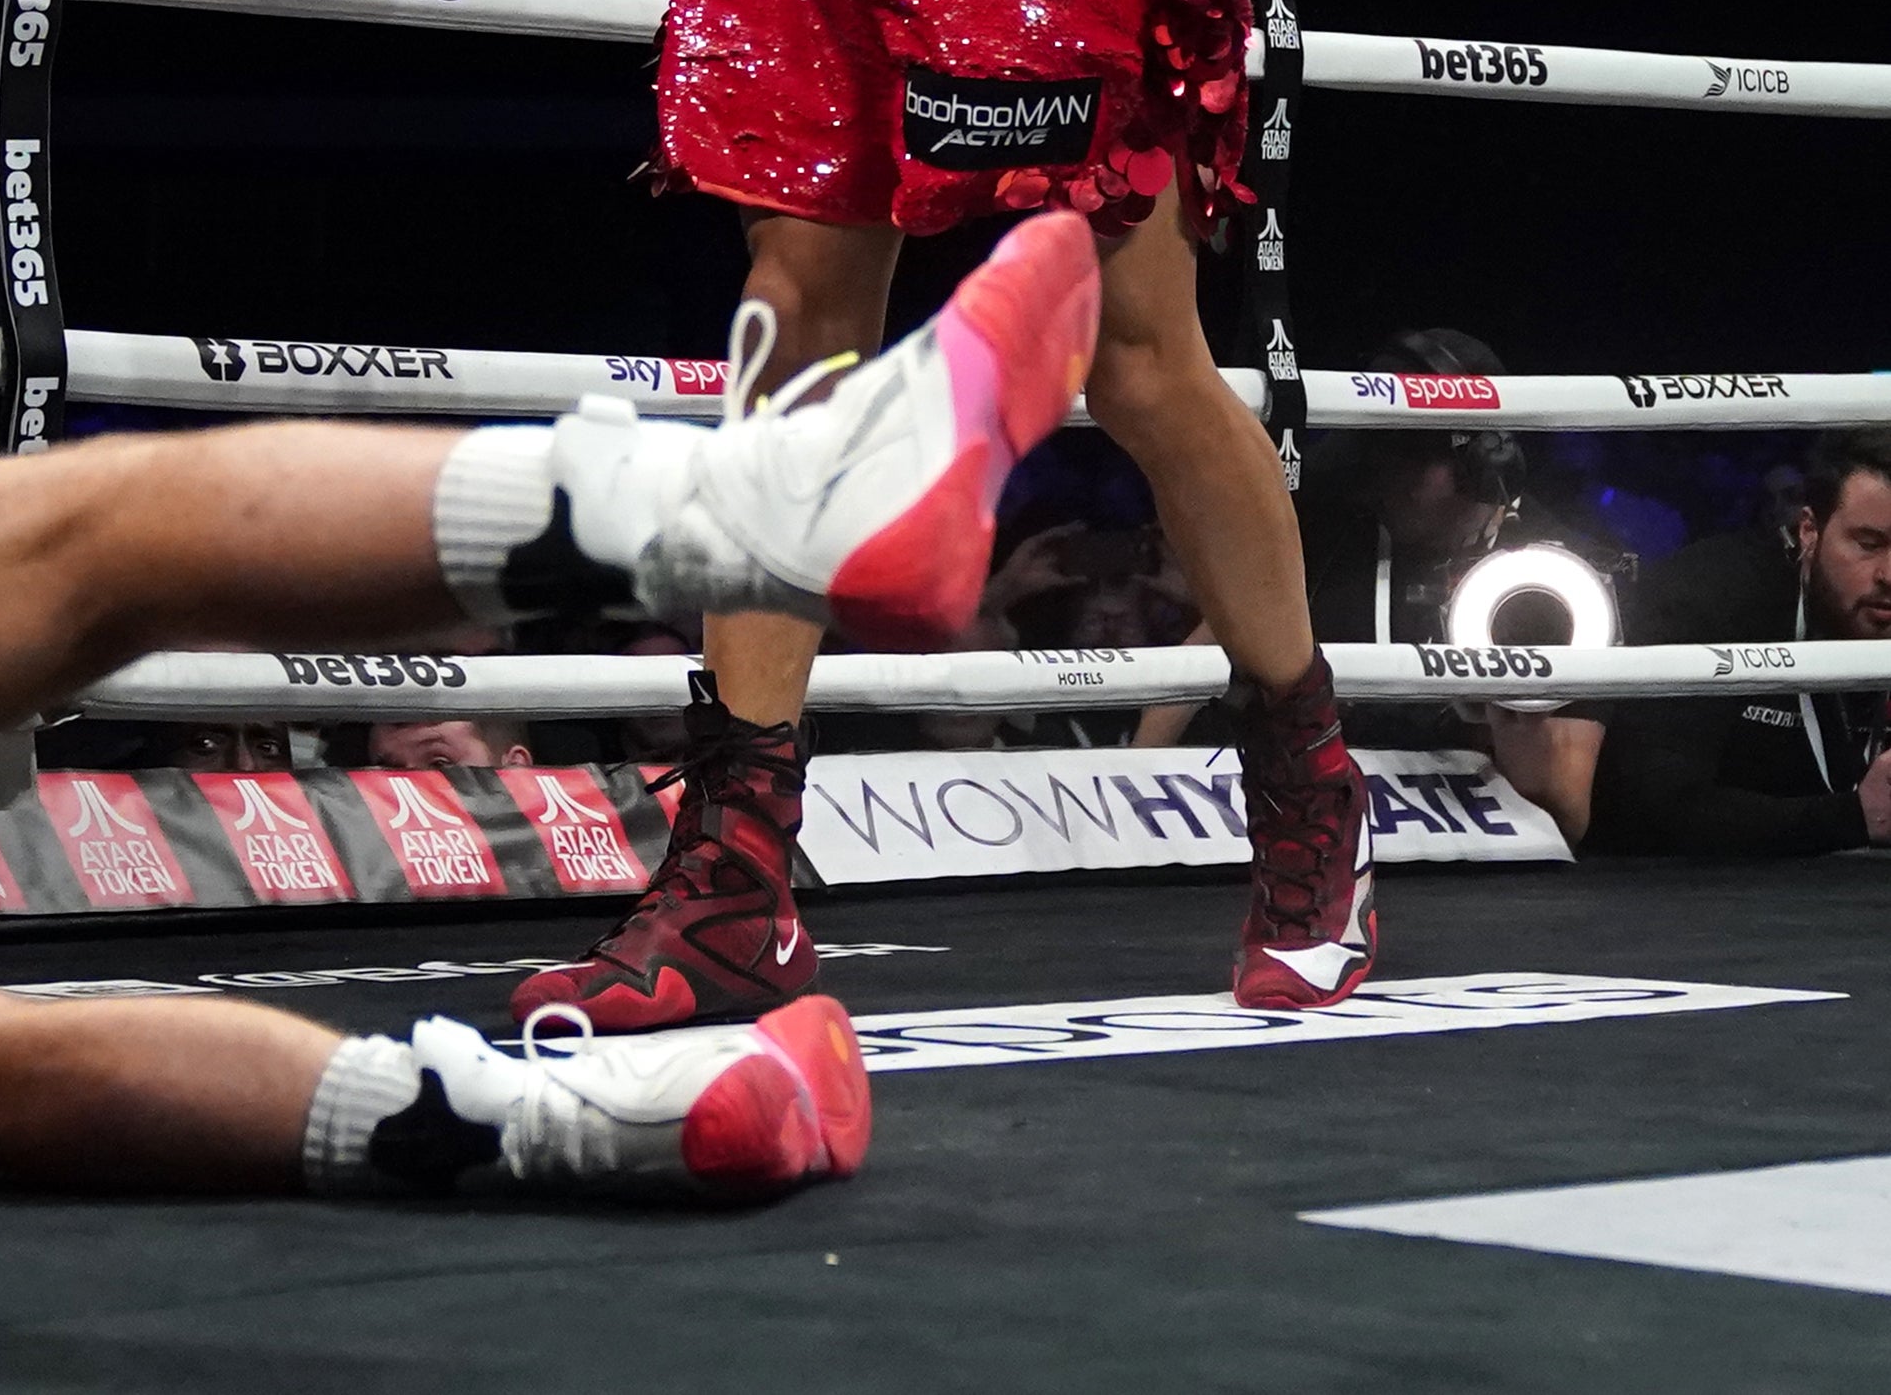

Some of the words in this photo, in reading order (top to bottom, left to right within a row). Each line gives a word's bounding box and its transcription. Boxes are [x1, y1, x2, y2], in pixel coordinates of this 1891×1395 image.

[1267, 17, 1299, 34] ATARI
[1269, 31, 1301, 49] TOKEN
[1413, 39, 1549, 86] bet365
[1737, 68, 1791, 95] ICICB
[906, 80, 1092, 128] boohooMAN
[930, 127, 1052, 154] ACTIVE
[1261, 144, 1290, 161] TOKEN
[1262, 130, 1291, 147] ATARI
[5, 138, 49, 309] bet365
[1258, 240, 1285, 256] ATARI
[1258, 254, 1284, 271] TOKEN
[251, 343, 455, 381] BOXXER
[605, 356, 662, 391] sky
[1268, 350, 1297, 368] ATARI
[1270, 365, 1300, 381] TOKEN
[1351, 372, 1397, 405] sky
[1407, 375, 1494, 407] sports
[1662, 375, 1790, 401] BOXXER
[275, 652, 468, 688] bet365
[1416, 642, 1554, 679] bet365
[1739, 645, 1796, 671] ICICB
[1057, 672, 1104, 686] HOTELS
[80, 839, 161, 869] ATARI
[245, 832, 323, 862] ATARI
[400, 828, 478, 859] ATARI
[551, 825, 622, 857] ATARI
[84, 866, 177, 896] TOKEN
[251, 858, 339, 891] TOKEN
[408, 854, 491, 886] TOKEN
[555, 853, 637, 882] TOKEN
